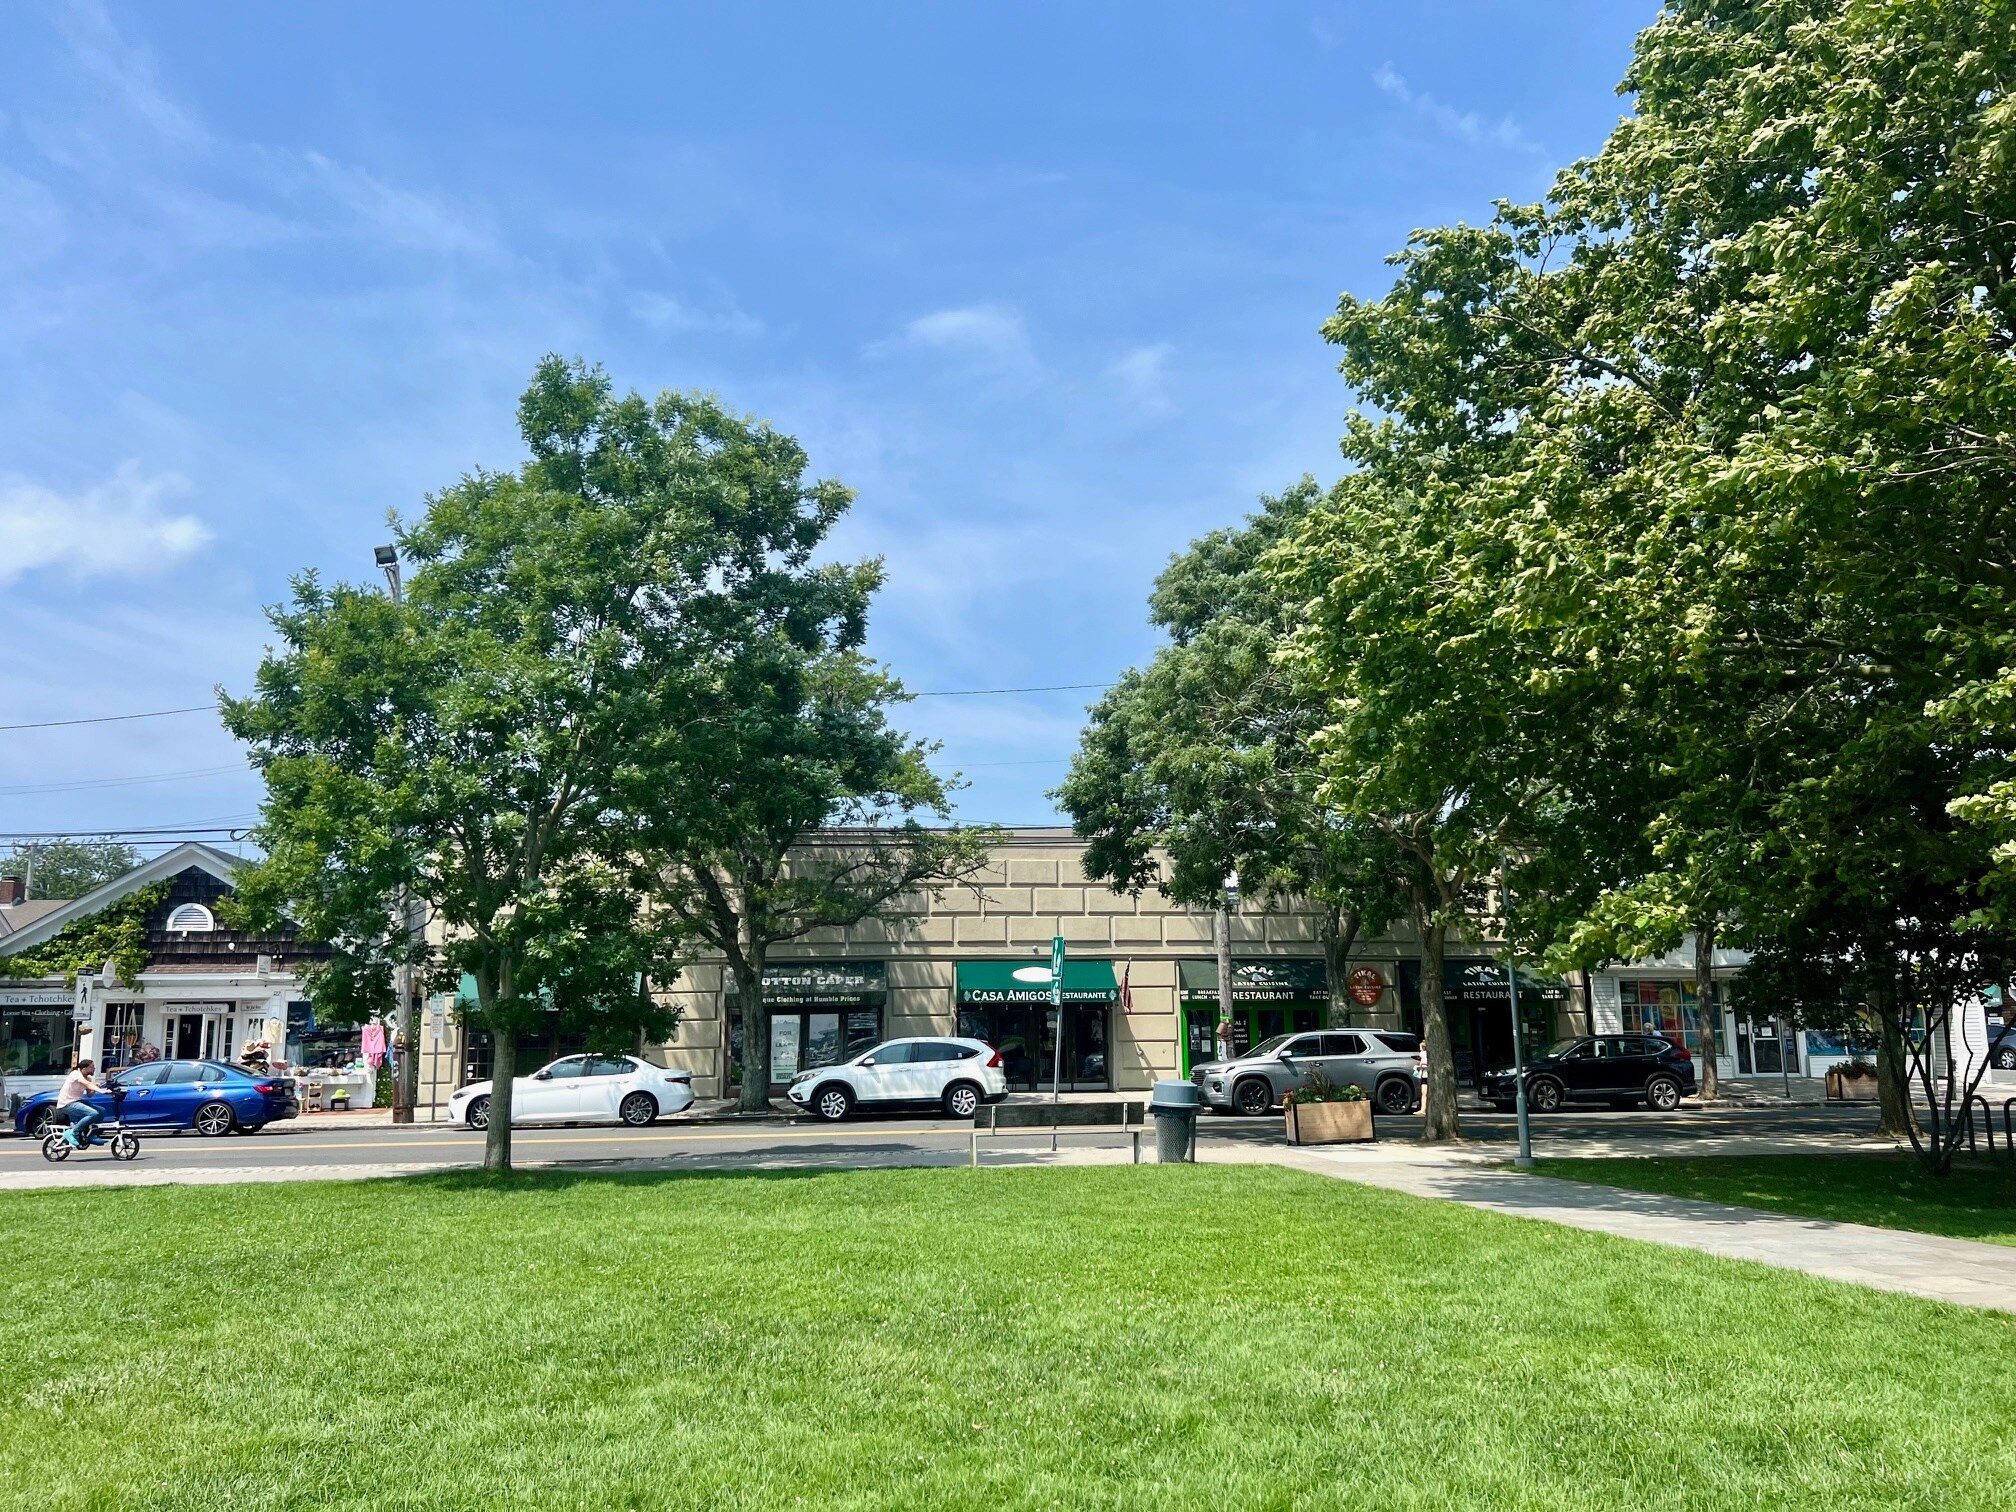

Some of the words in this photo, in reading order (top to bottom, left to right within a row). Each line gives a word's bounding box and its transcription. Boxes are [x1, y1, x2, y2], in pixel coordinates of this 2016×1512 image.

[1236, 965, 1274, 976] TIKAL
[1464, 965, 1500, 976] TIKAL
[761, 977, 812, 986] OTTON
[816, 976, 864, 985] CAPER
[776, 996, 804, 1004] Clothing
[972, 990, 1004, 1001] CASA
[1007, 990, 1052, 1001] AMIGOS
[1232, 991, 1295, 1000] RESTAURANT
[1464, 991, 1523, 999] RESTAURAT
